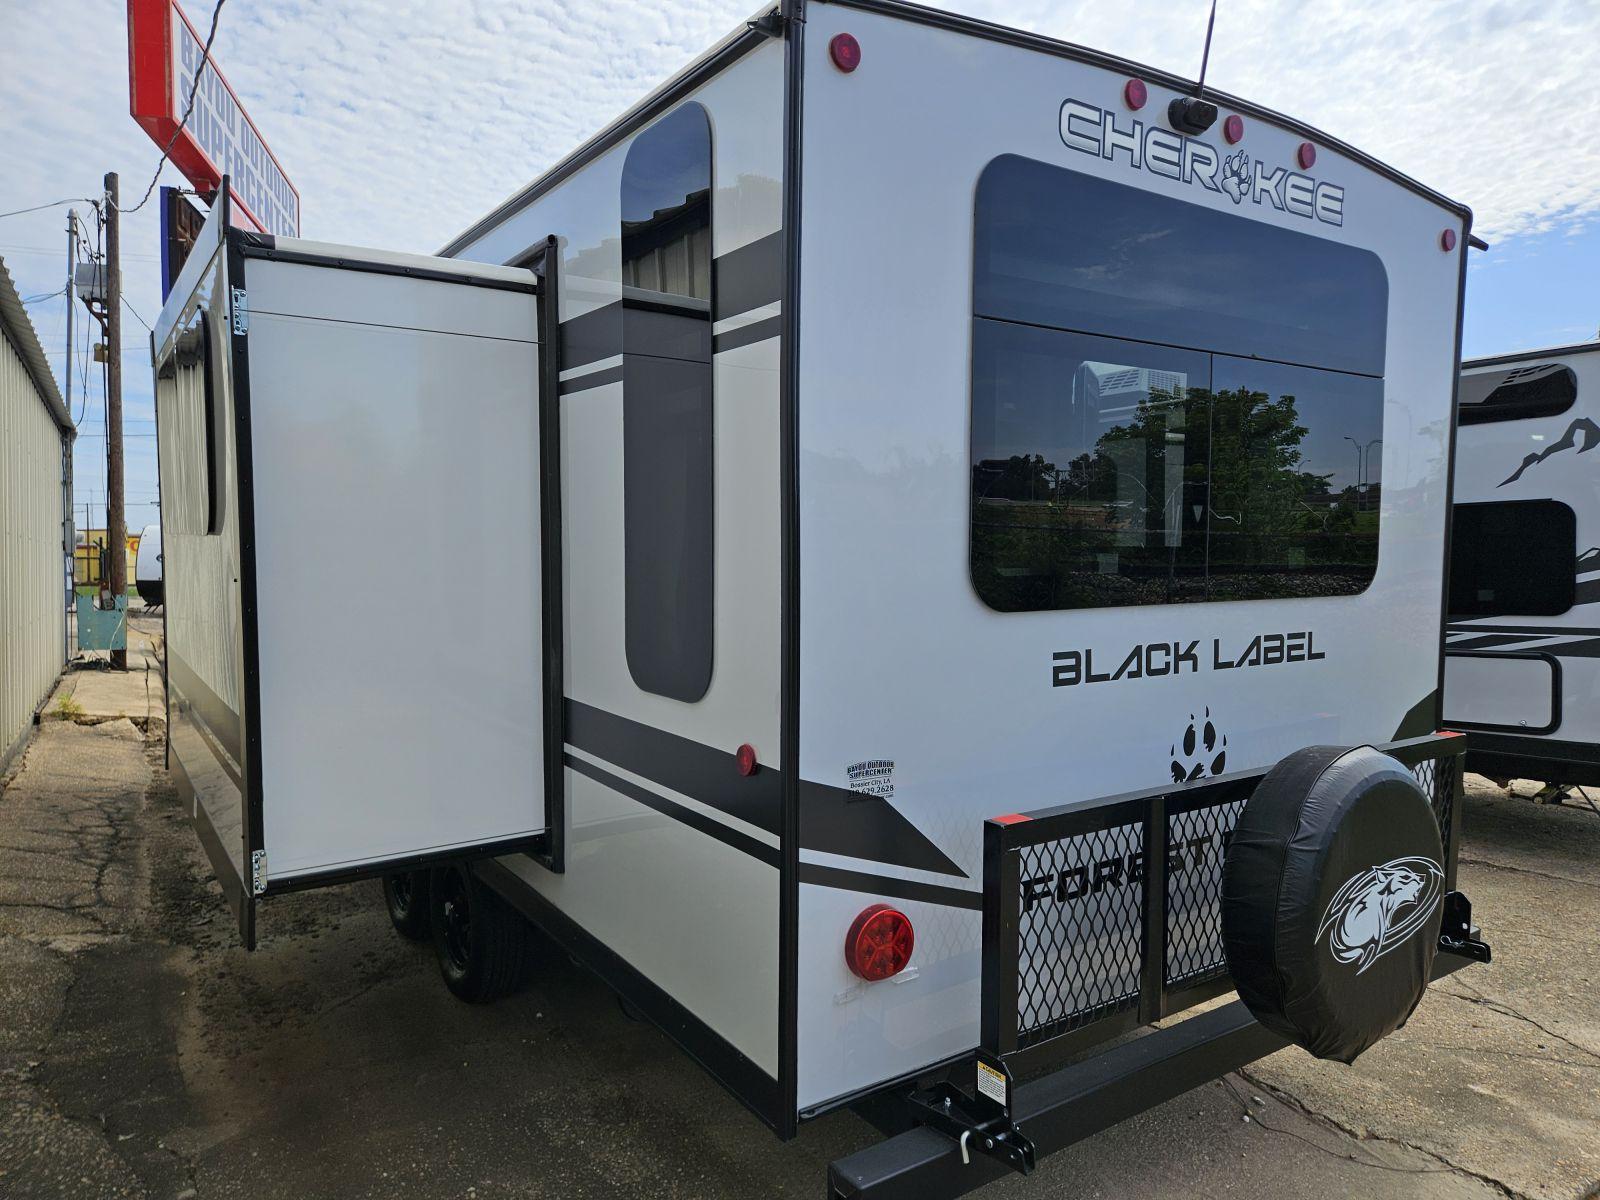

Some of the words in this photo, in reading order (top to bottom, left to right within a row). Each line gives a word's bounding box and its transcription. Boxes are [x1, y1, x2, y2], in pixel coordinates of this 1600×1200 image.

[180, 21, 236, 137] BAYOU
[240, 116, 296, 222] OUTDOOR
[1052, 640, 1200, 687] BLACK
[1213, 631, 1326, 670] LABEL
[847, 762, 866, 774] BAYOU
[849, 768, 892, 778] SUPERCENTER
[850, 781, 870, 789] Bossier
